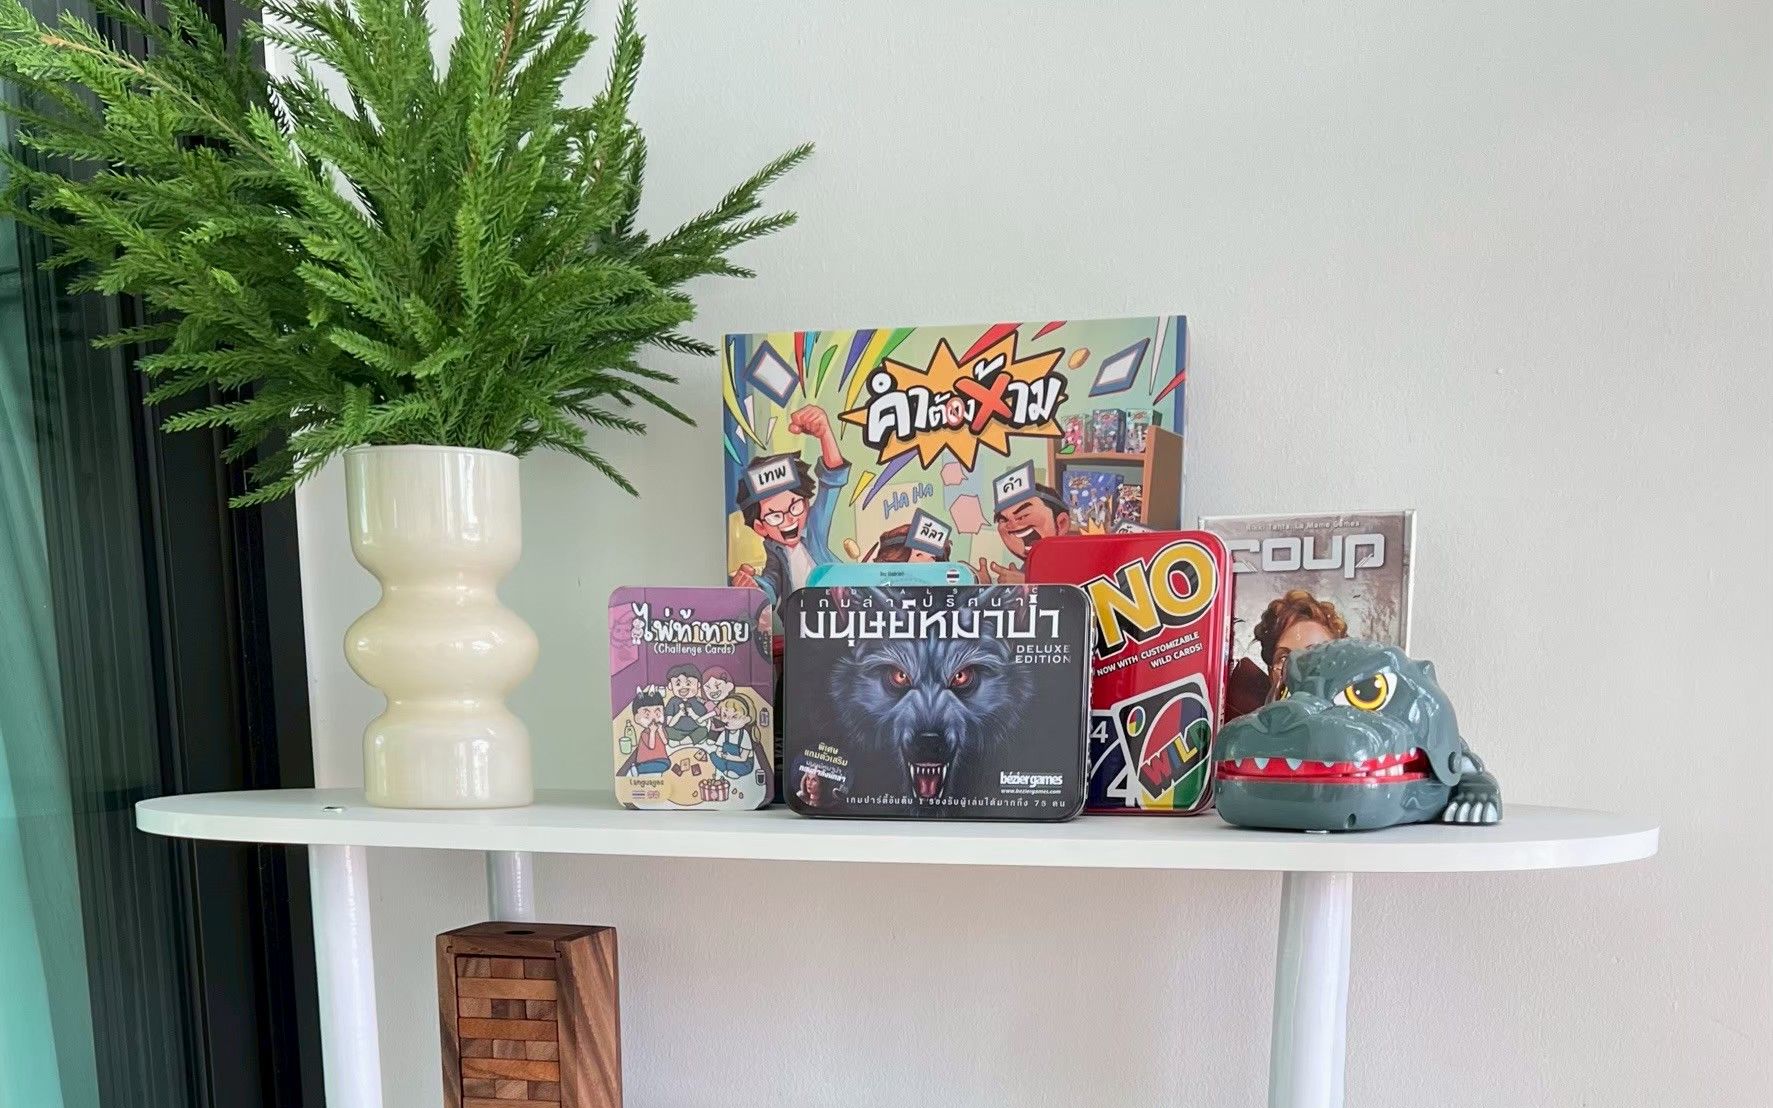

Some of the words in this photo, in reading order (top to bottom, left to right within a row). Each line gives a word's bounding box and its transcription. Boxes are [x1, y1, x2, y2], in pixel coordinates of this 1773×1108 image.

[758, 465, 787, 486] เทพ
[883, 490, 910, 519] HA
[913, 482, 934, 504] HA
[1089, 543, 1216, 658] NO
[632, 602, 749, 643] ไพ่ท้าทาย
[800, 594, 1060, 647] มนุษย์หมาป่า
[653, 643, 702, 656] (Challenge
[704, 643, 736, 655] Cards)
[1015, 655, 1072, 664] EDITION
[1016, 644, 1071, 654] DELUXE
[1097, 664, 1116, 676] NOW
[1117, 655, 1139, 669] WITH
[1140, 631, 1200, 660] CUSTOMIZABLE
[1150, 655, 1173, 668] WILD
[1173, 642, 1203, 660] CARDS!
[1142, 721, 1211, 786] WILD
